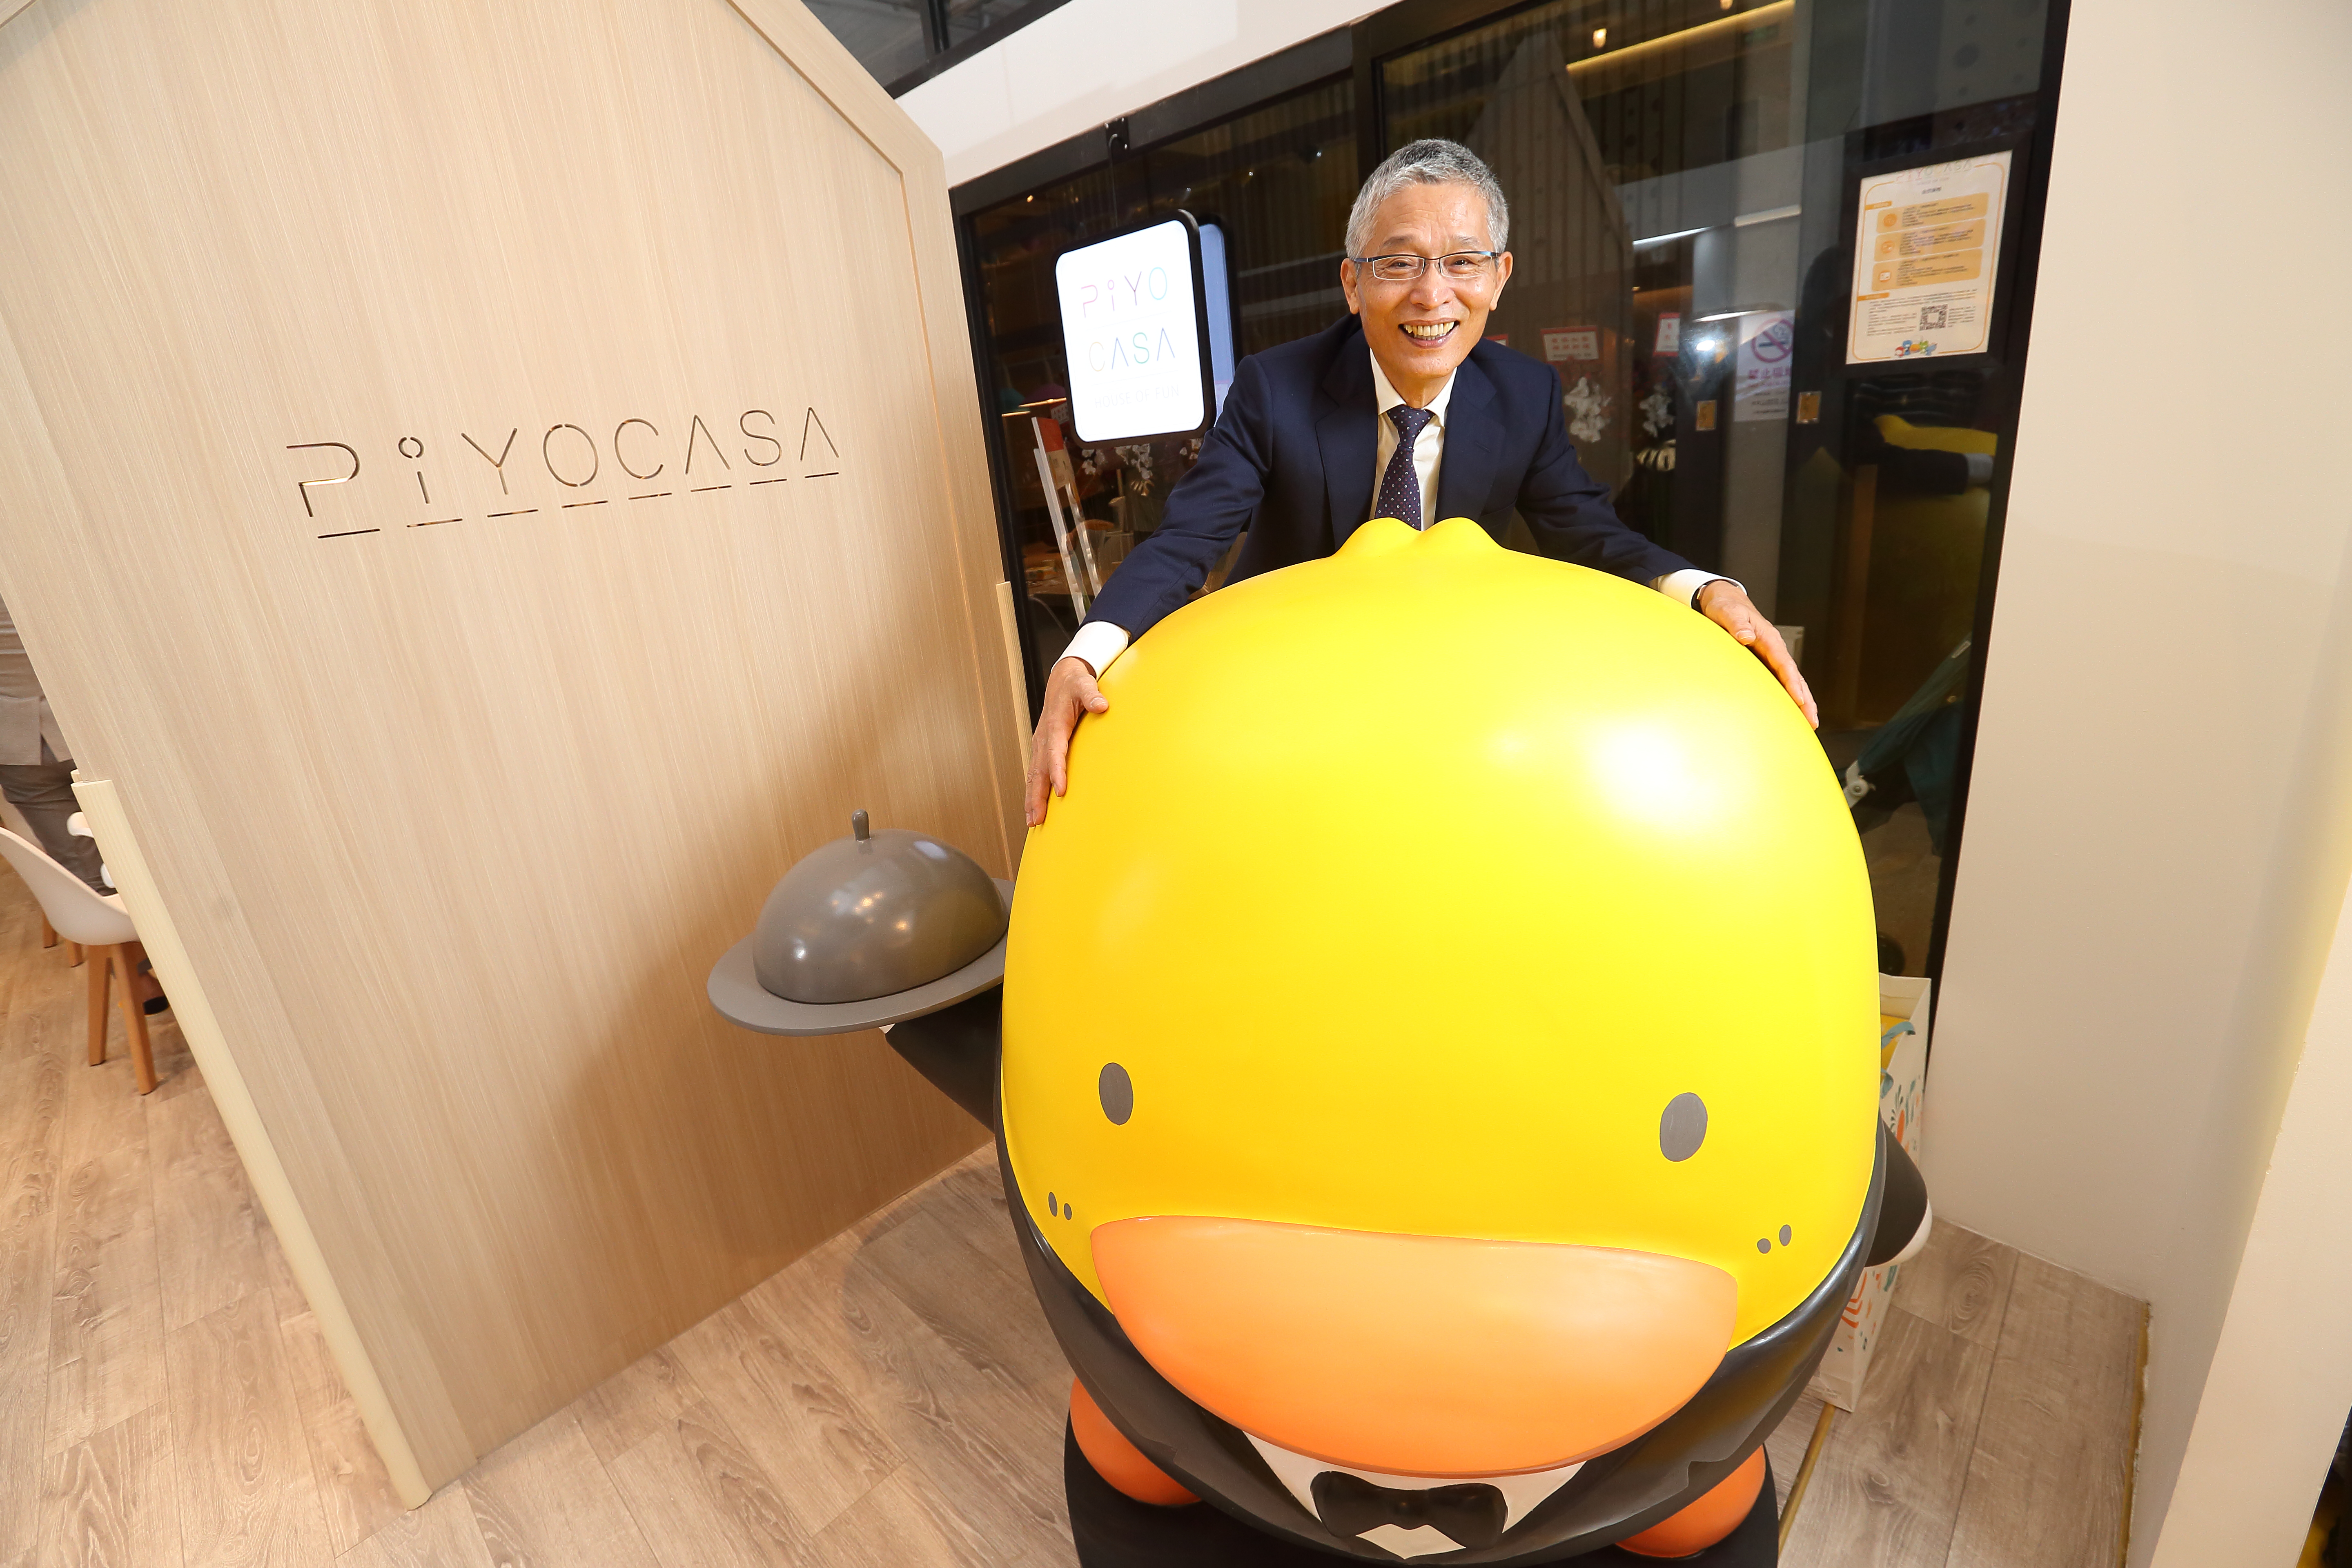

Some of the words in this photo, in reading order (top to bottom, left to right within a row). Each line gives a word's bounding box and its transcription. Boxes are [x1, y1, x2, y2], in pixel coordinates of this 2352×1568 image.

[1089, 327, 1175, 372] CASA
[1095, 392, 1132, 409] HOUSE
[1136, 389, 1150, 402] OF
[1155, 384, 1179, 400] FUN
